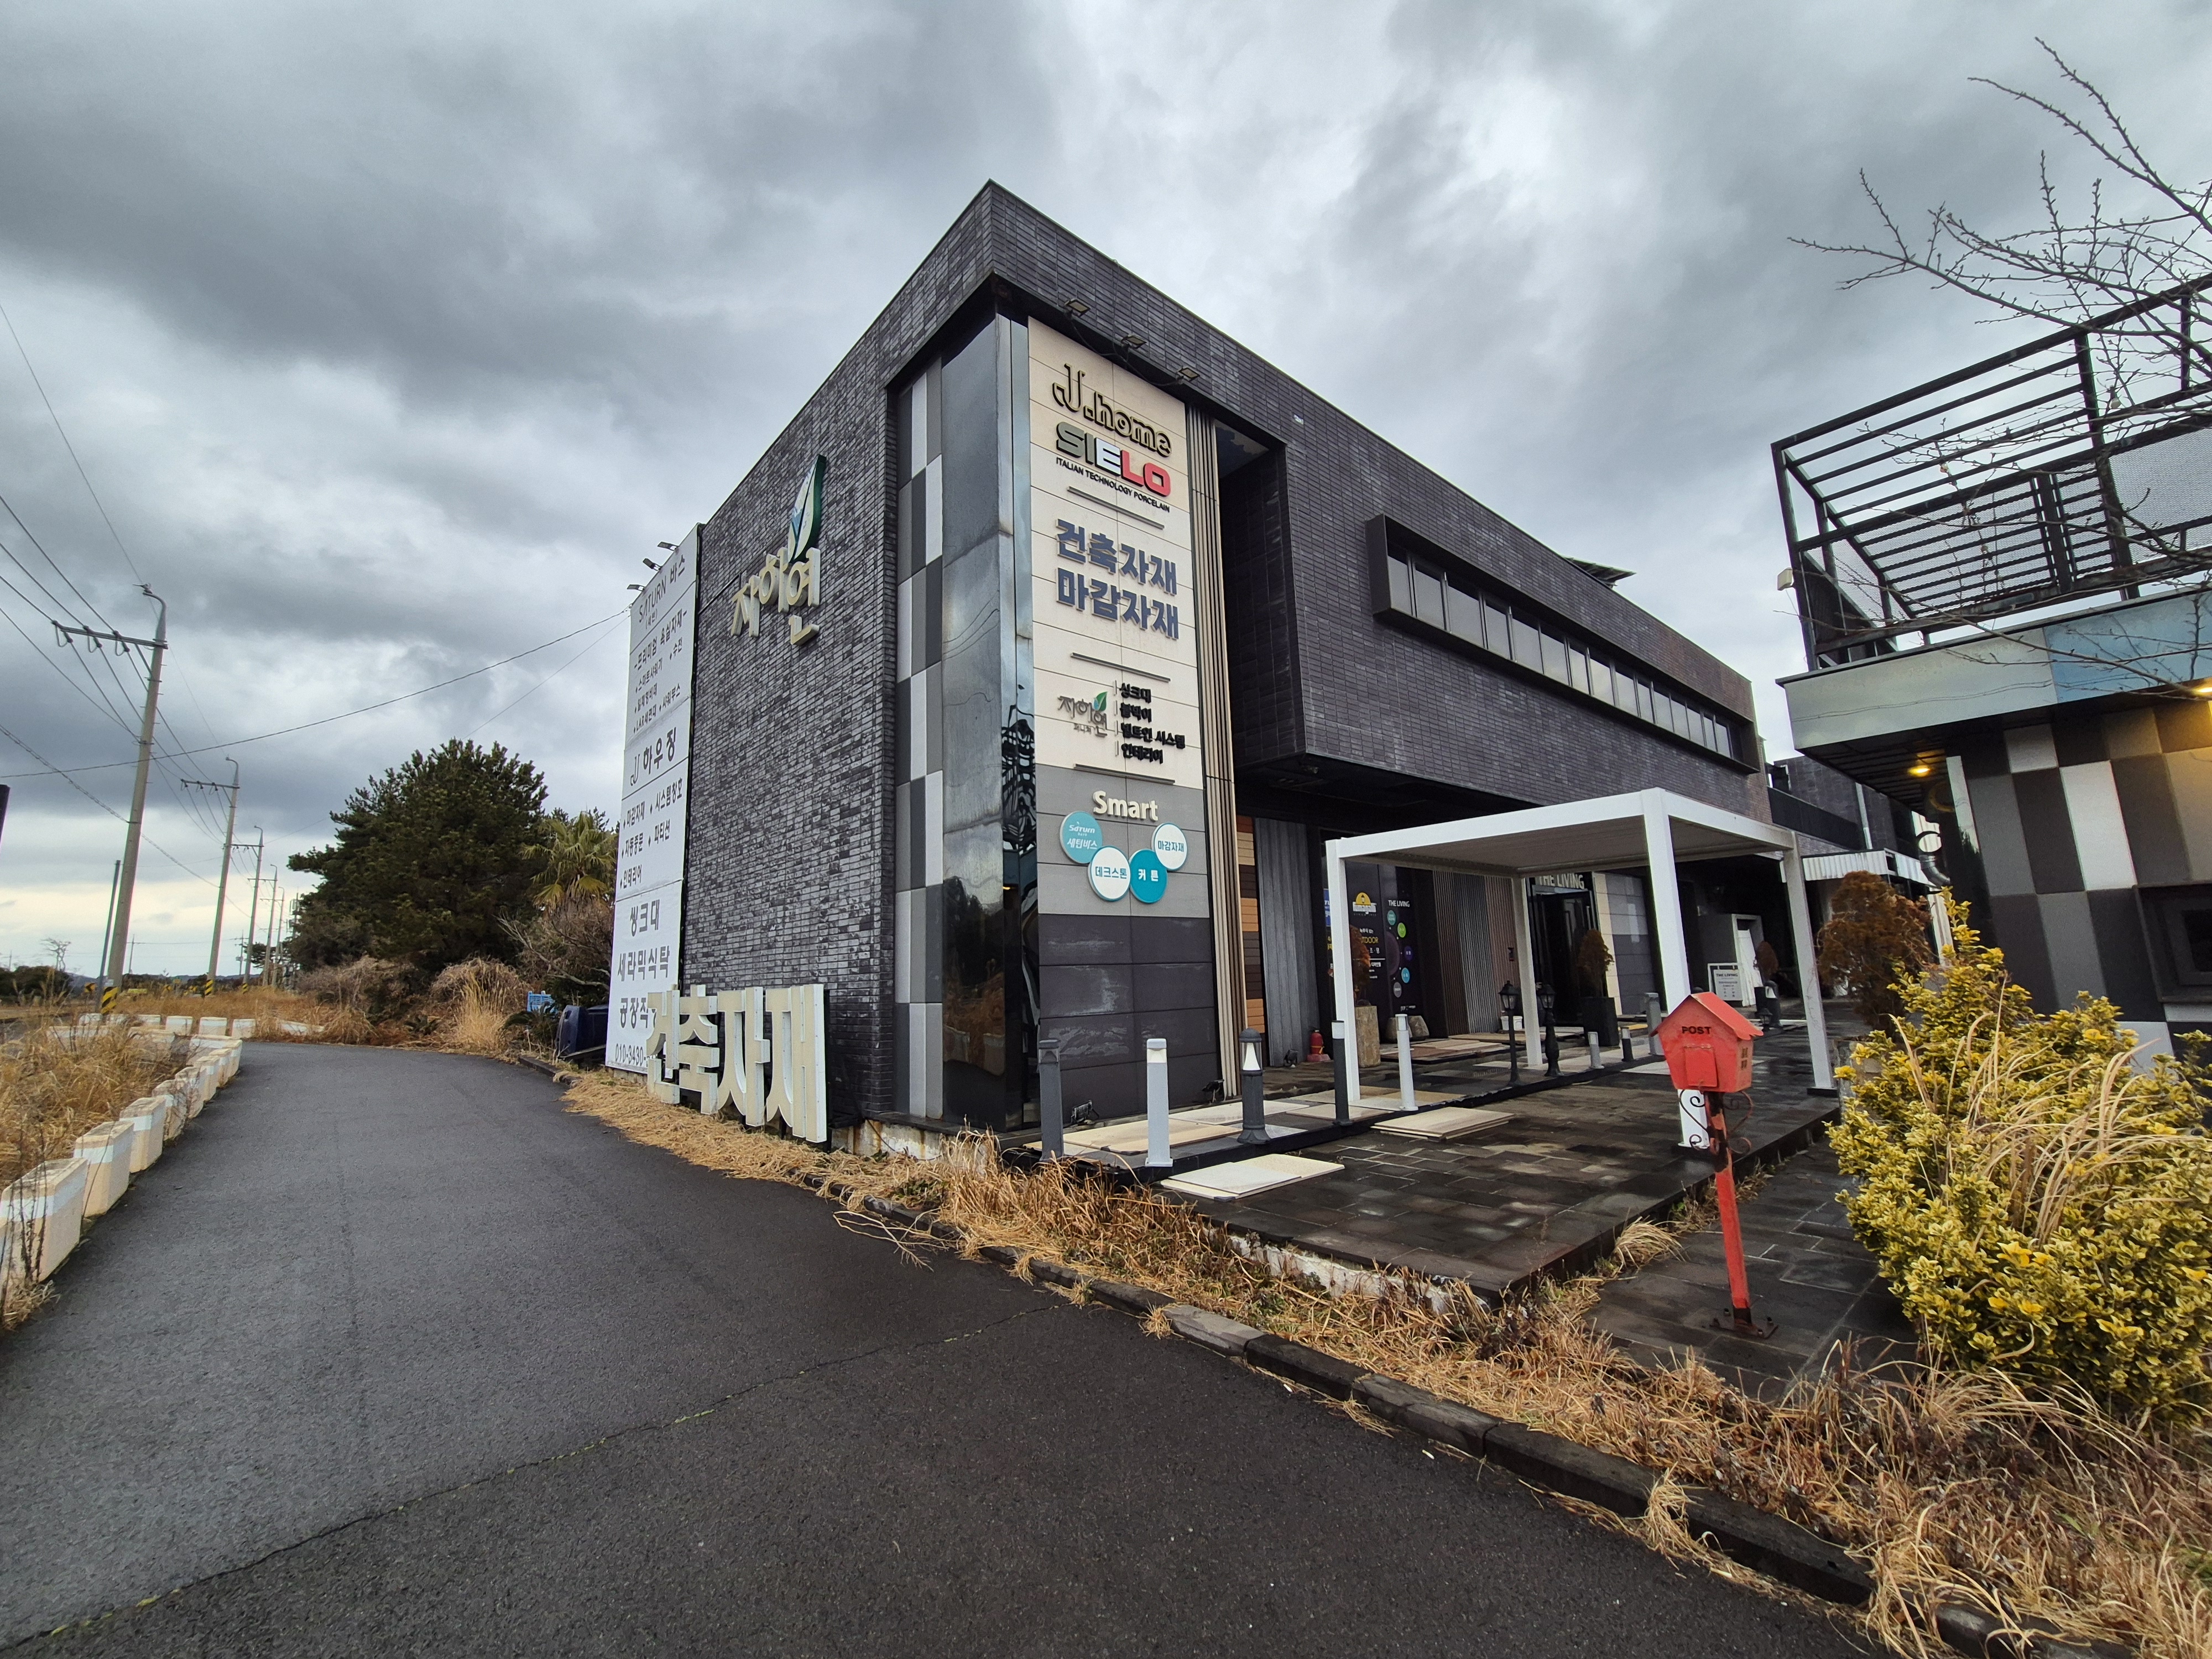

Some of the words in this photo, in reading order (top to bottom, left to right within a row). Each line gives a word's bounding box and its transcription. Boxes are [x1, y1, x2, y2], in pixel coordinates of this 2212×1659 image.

[1052, 363, 1172, 457] J.home
[1056, 421, 1171, 497] SIELO
[1056, 457, 1084, 476] ITALIAN
[1086, 469, 1133, 496] TECHNOLOGY
[1134, 491, 1170, 513] PORCELAIN
[1056, 519, 1177, 596] 건축자재
[639, 575, 666, 623] SATURN
[670, 554, 685, 583] 바스
[1056, 567, 1179, 640] 마감자재
[673, 637, 682, 656] 수전
[662, 683, 680, 708] 샤워부스
[1119, 683, 1151, 703] 싱크대
[643, 727, 676, 775] 하우징
[1121, 723, 1153, 743] 빌트인
[1155, 731, 1186, 749] 시스템
[1121, 743, 1164, 764] 인테리어
[627, 801, 645, 827] 마감자재
[655, 778, 682, 811] 시스템창호
[1093, 790, 1158, 821] Smart
[625, 832, 643, 857] 자동중문
[654, 818, 670, 844] 파티션
[1158, 840, 1185, 853] 마감자재
[623, 864, 642, 889] 인테리어
[1095, 866, 1127, 879] 데크스톤
[1540, 875, 1555, 886] THE
[1557, 873, 1584, 889] LIVING
[618, 946, 670, 982] 세라믹식탁
[620, 998, 656, 1029] 공장직
[1682, 1026, 1712, 1035] POST
[646, 984, 827, 1142] 건축자재
